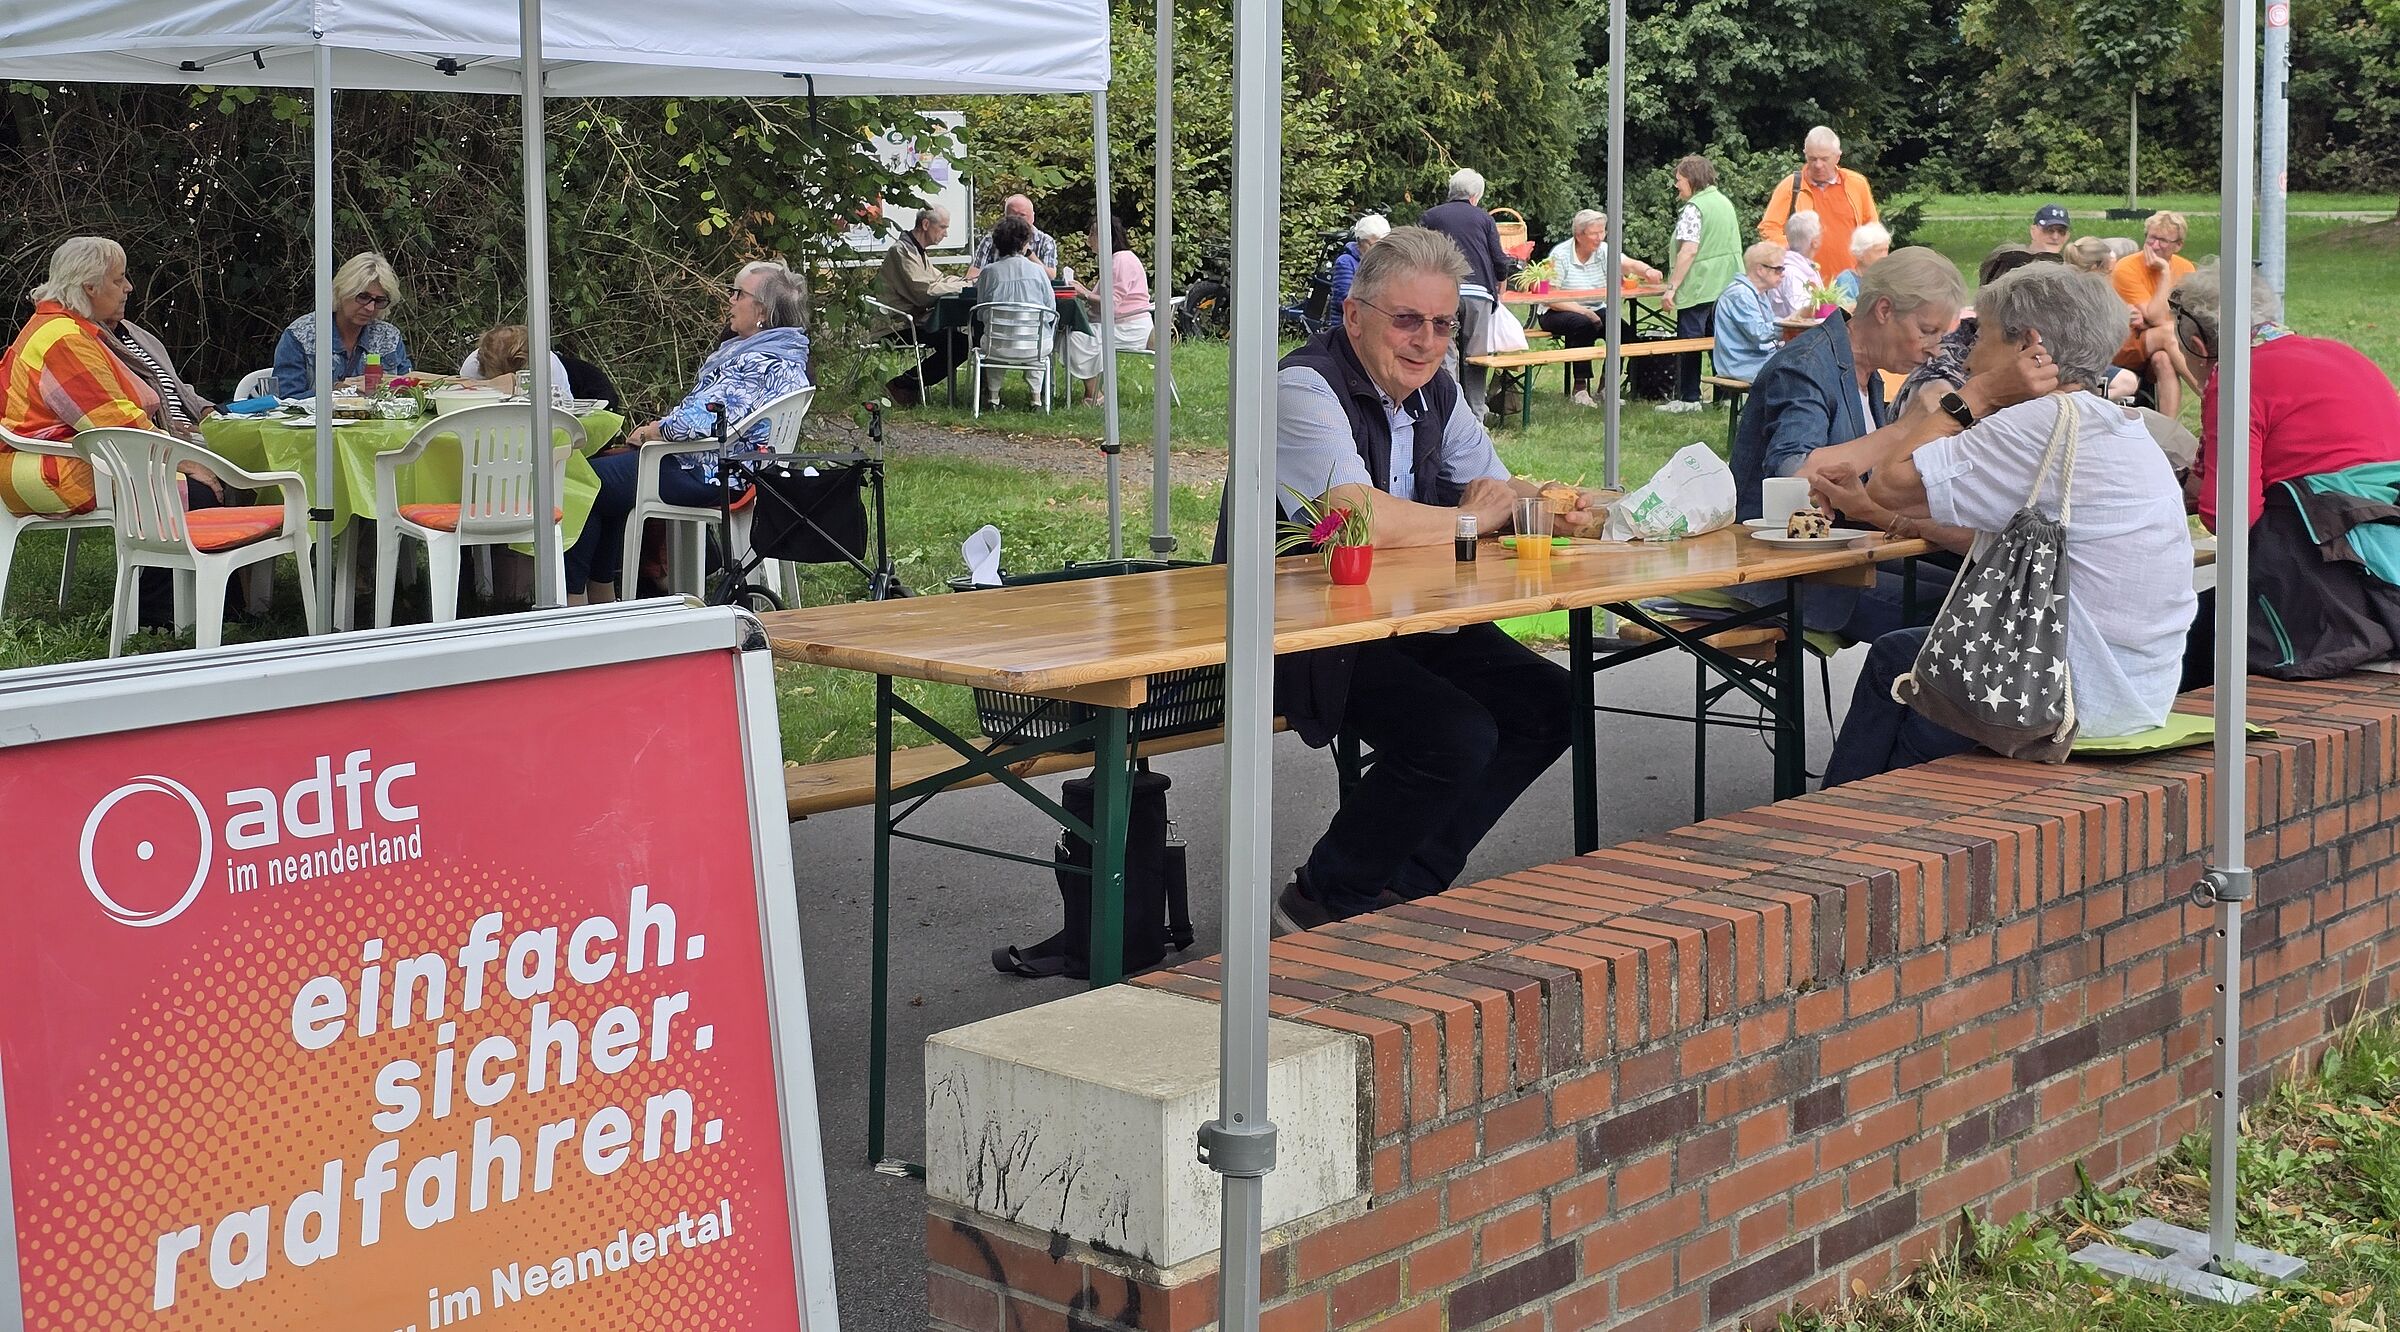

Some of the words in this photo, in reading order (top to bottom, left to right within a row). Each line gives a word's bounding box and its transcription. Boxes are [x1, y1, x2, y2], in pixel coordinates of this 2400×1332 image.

[225, 748, 420, 851] adfc
[226, 858, 259, 895] im
[268, 823, 423, 887] neanderland
[291, 884, 706, 1051] einfach.
[371, 991, 715, 1133] sicher.
[152, 1088, 723, 1311] radfahren.
[428, 1286, 482, 1331] im
[491, 1198, 734, 1309] Neandertal
